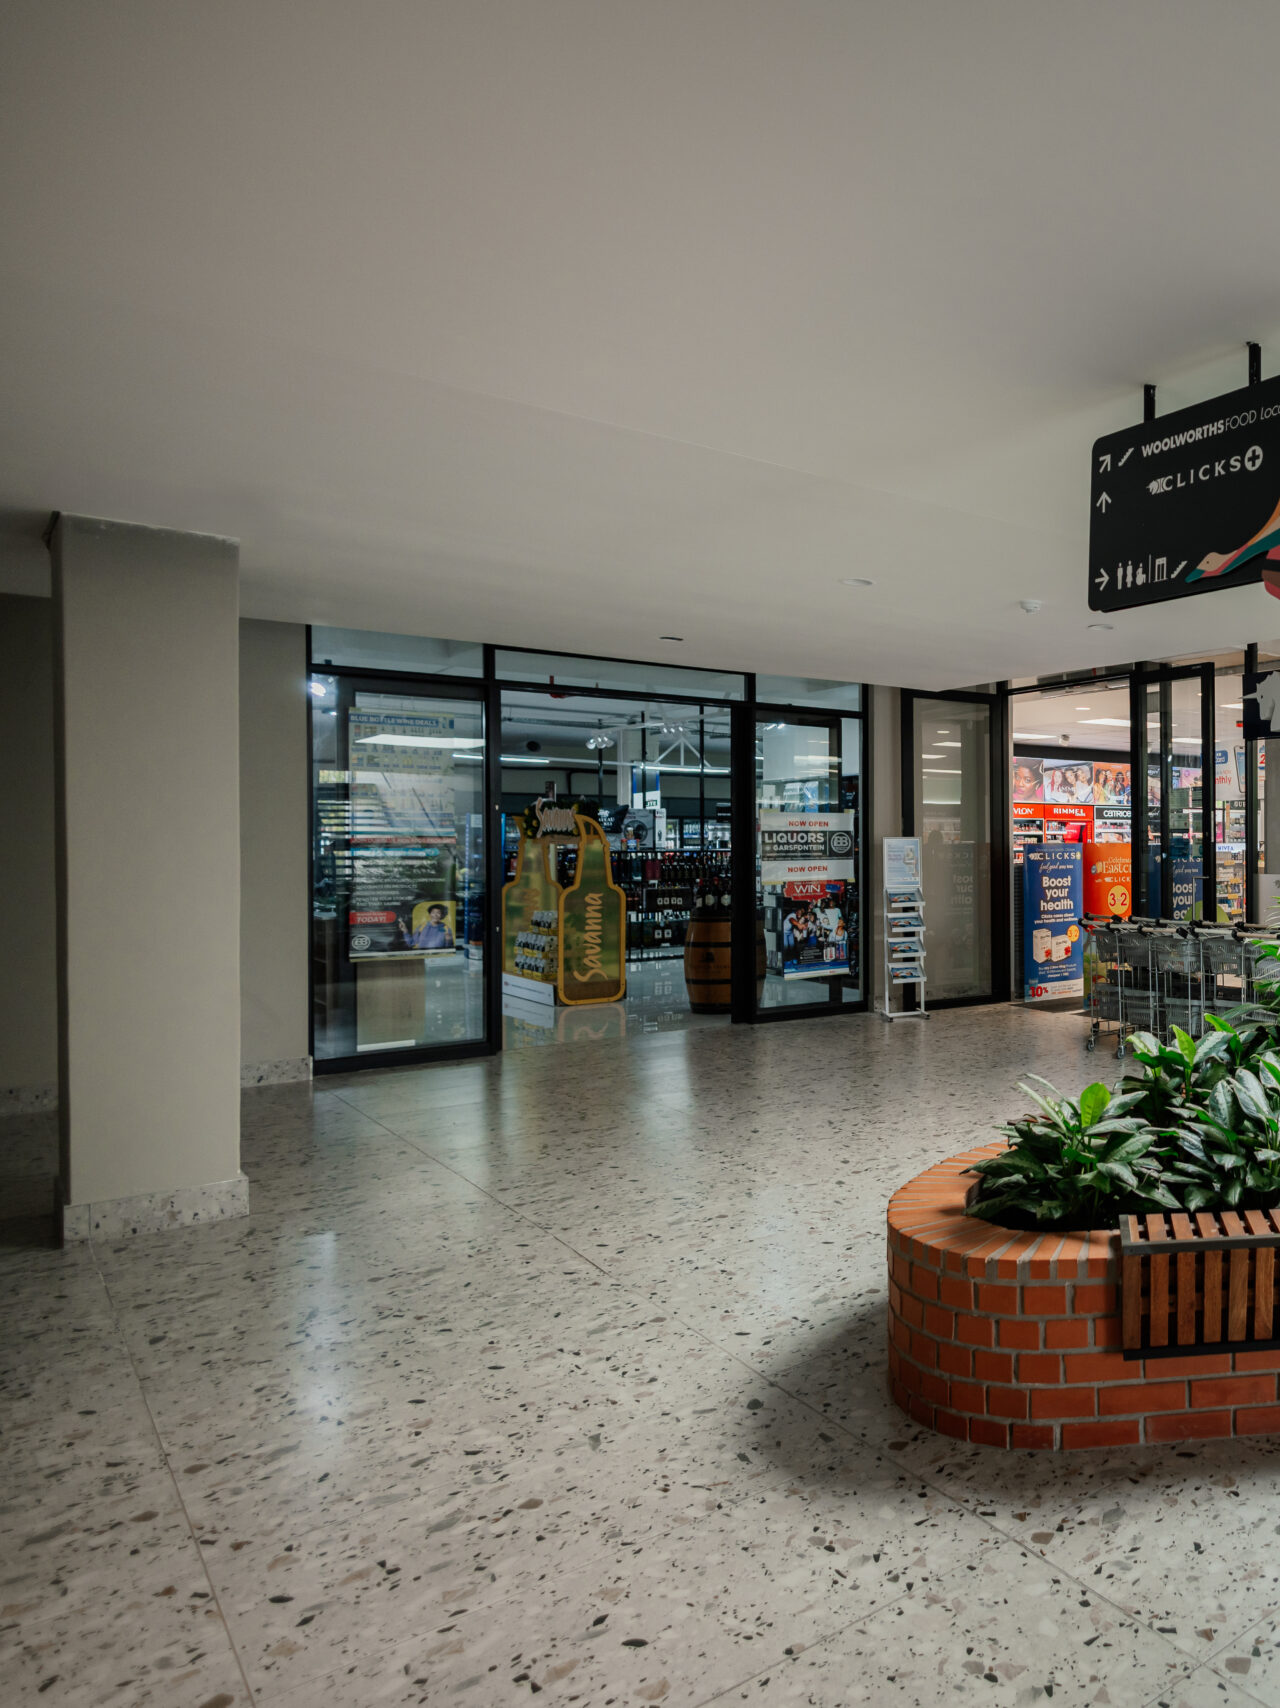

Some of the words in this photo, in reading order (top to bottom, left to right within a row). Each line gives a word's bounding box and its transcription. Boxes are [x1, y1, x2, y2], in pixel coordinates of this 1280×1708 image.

[1162, 455, 1241, 491] CLICKS
[1215, 775, 1232, 784] nthly
[1013, 807, 1034, 815] VLON
[1053, 807, 1084, 815] RIMMEL
[764, 832, 824, 843] LIQUORS
[1037, 852, 1076, 860] CLICKS
[1042, 875, 1072, 888] Boost
[794, 885, 820, 893] WIN
[1045, 888, 1069, 900] your
[1040, 899, 1074, 911] health
[572, 893, 608, 982] Savanna
[1030, 985, 1049, 998] 10%
